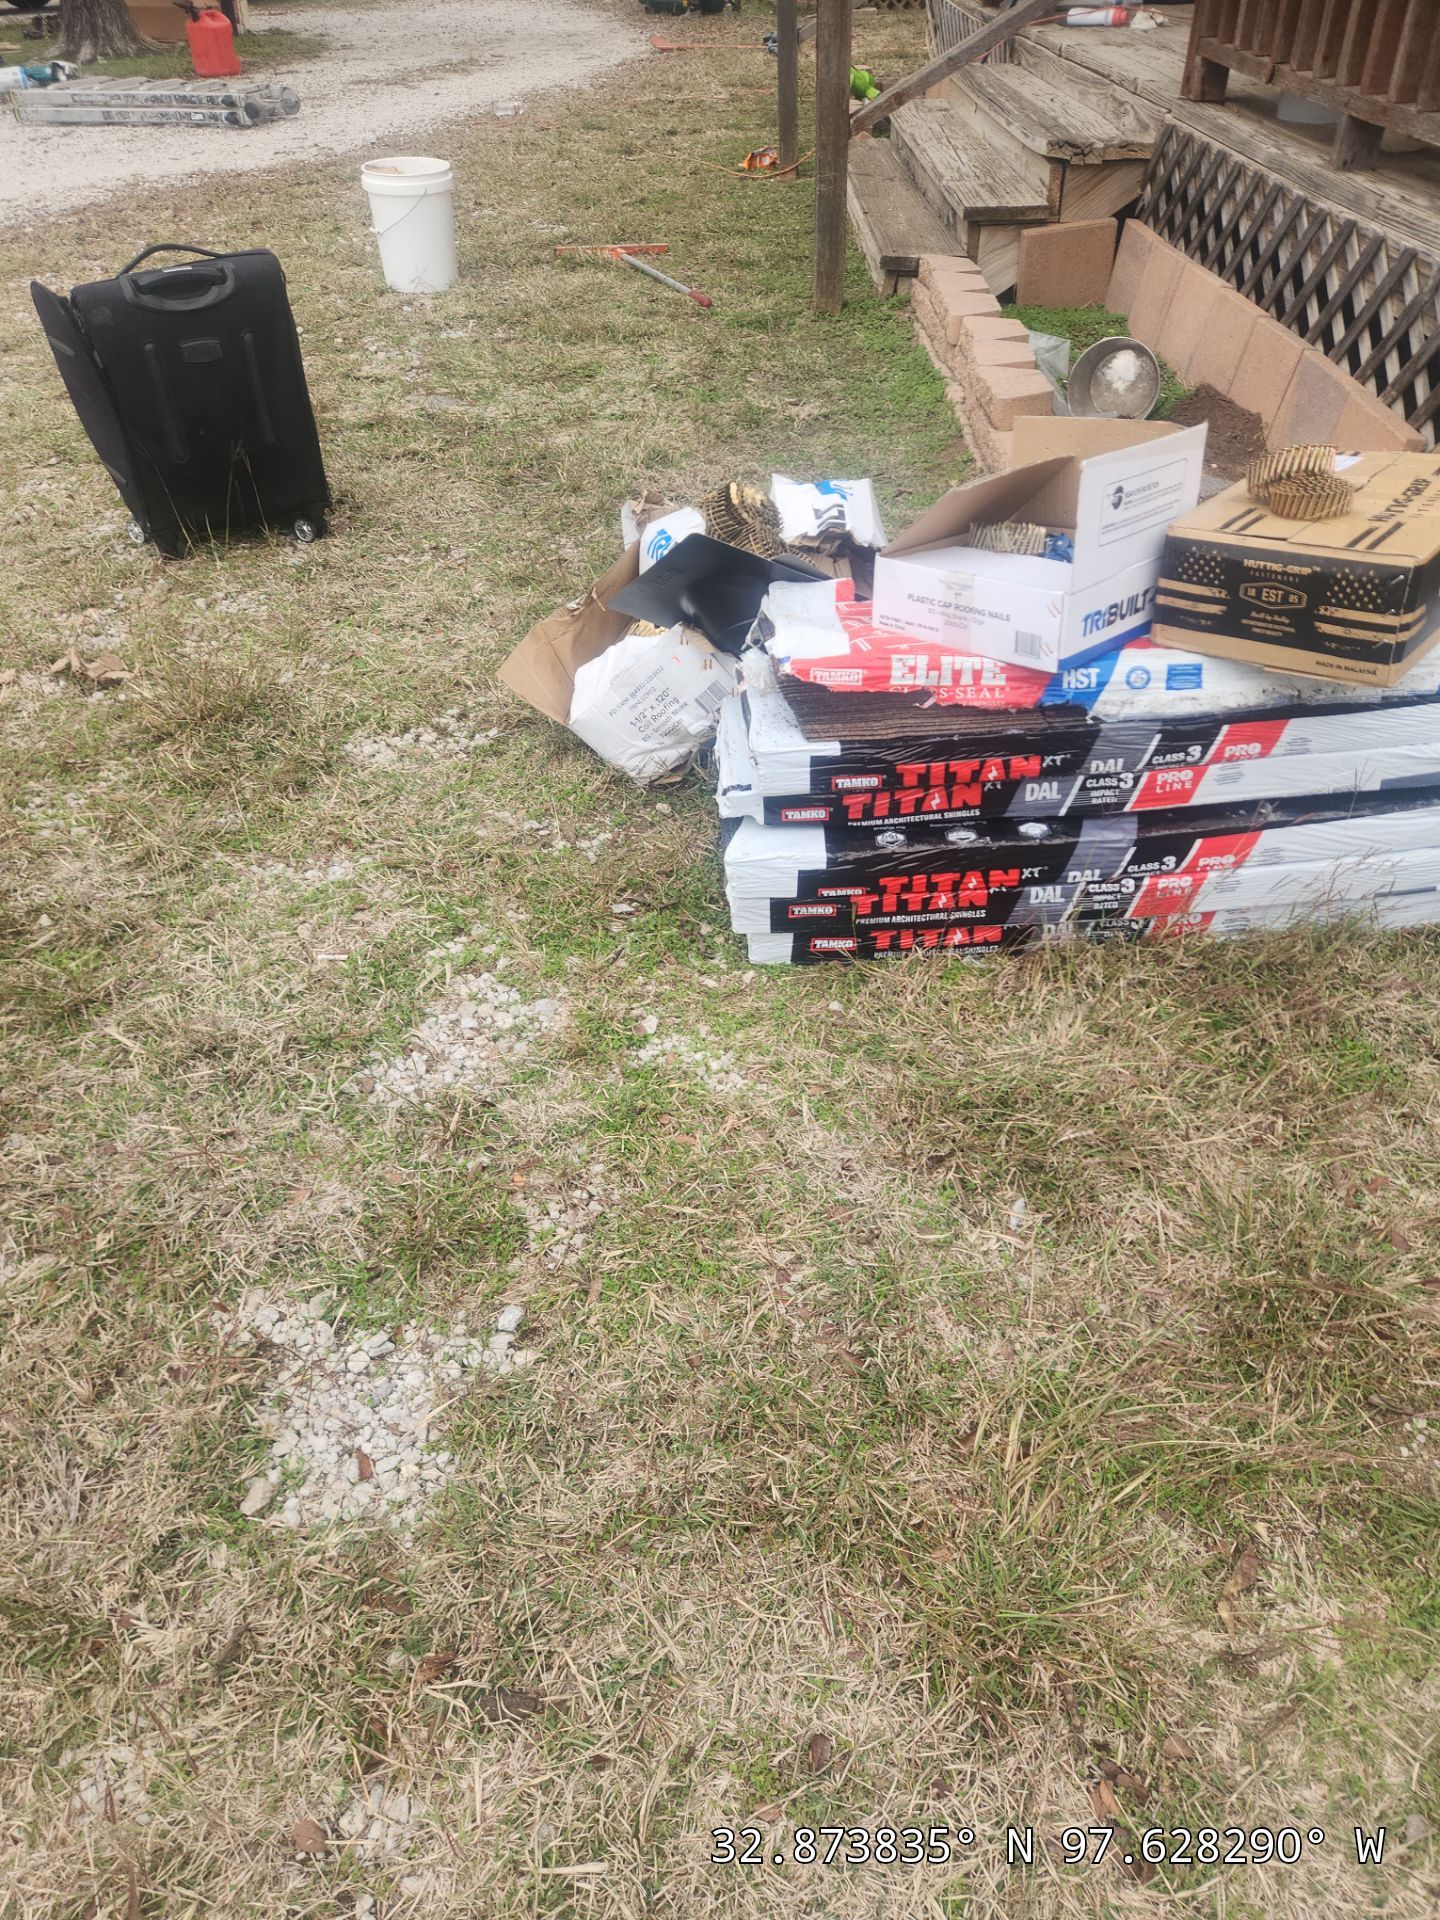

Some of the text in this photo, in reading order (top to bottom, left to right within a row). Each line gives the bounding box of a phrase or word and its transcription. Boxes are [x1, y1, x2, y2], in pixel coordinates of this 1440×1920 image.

[1261, 587, 1285, 604] EST
[907, 593, 1011, 622] PLASTIC CAP ROOFING NAILS
[813, 670, 860, 683] TAMKO
[890, 654, 1007, 686] ELITE
[1062, 668, 1100, 689] HST
[638, 719, 651, 734] Coil
[651, 697, 680, 723] Roofing
[1152, 745, 1203, 765] CLASS 3
[1224, 742, 1262, 758] PRO
[835, 755, 1066, 789] TAMKO TITAN XT
[1157, 769, 1194, 785] PRO
[1086, 773, 1134, 789] CLASS 3
[1156, 781, 1192, 793] LINE
[1024, 781, 1062, 801] DAL
[1090, 788, 1119, 797] IMPACT
[785, 809, 826, 820] TAMKO
[842, 783, 983, 820] TITAN
[883, 812, 943, 825] ARCHITECTURAL
[943, 809, 980, 819] SHINGLES
[1127, 856, 1177, 873] CLASS 3
[1198, 854, 1236, 868] PRO
[879, 868, 1020, 894] TITAN
[1021, 867, 1041, 880] XT
[1067, 869, 1103, 883] DAL
[1157, 876, 1193, 889] PRO
[1088, 878, 1135, 893] CLASS 3
[791, 889, 989, 916] TAMKO TITAN
[1029, 886, 1066, 905] DAL
[856, 909, 986, 925] PREMIUM ARCHITECTURAL SHINGLES
[814, 925, 1003, 949] TAMKO TITAN
